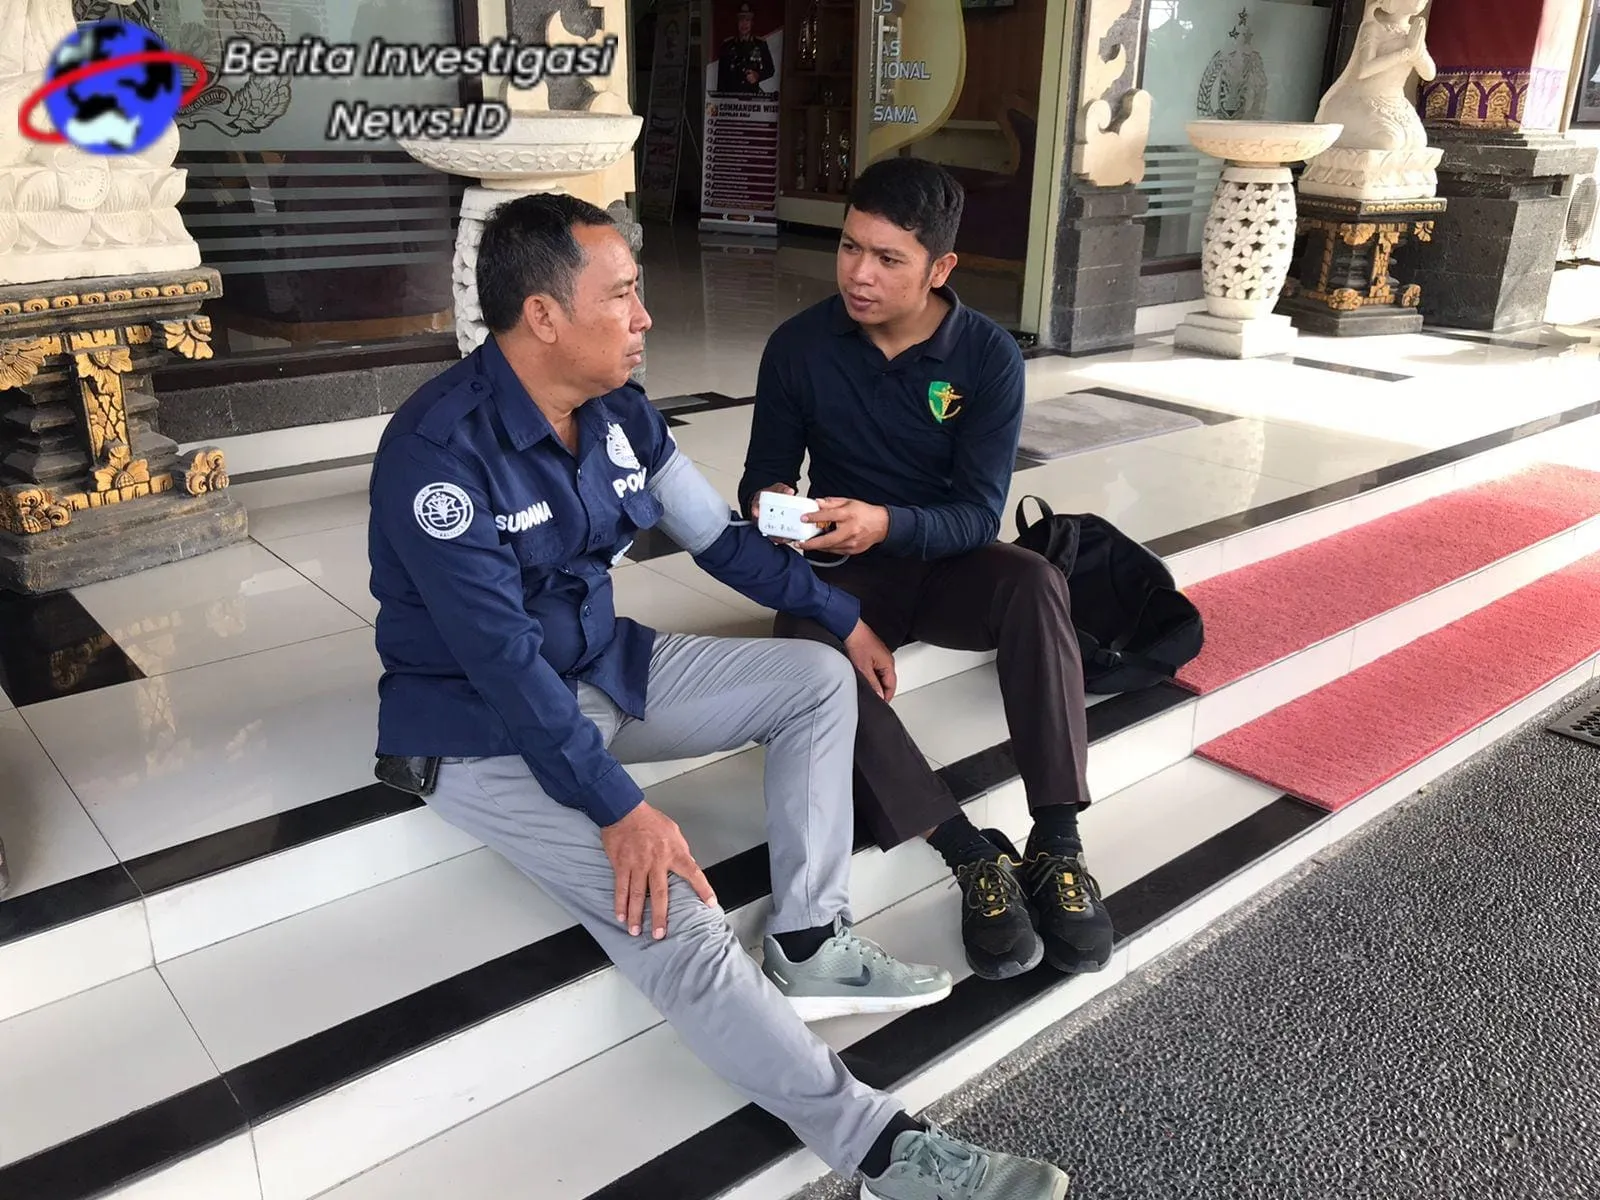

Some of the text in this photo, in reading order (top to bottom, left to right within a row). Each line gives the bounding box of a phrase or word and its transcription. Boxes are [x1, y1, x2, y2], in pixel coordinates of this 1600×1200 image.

[719, 103, 761, 112] COMMANDER
[873, 105, 919, 123] SAMA
[495, 500, 553, 533] SUDANA
